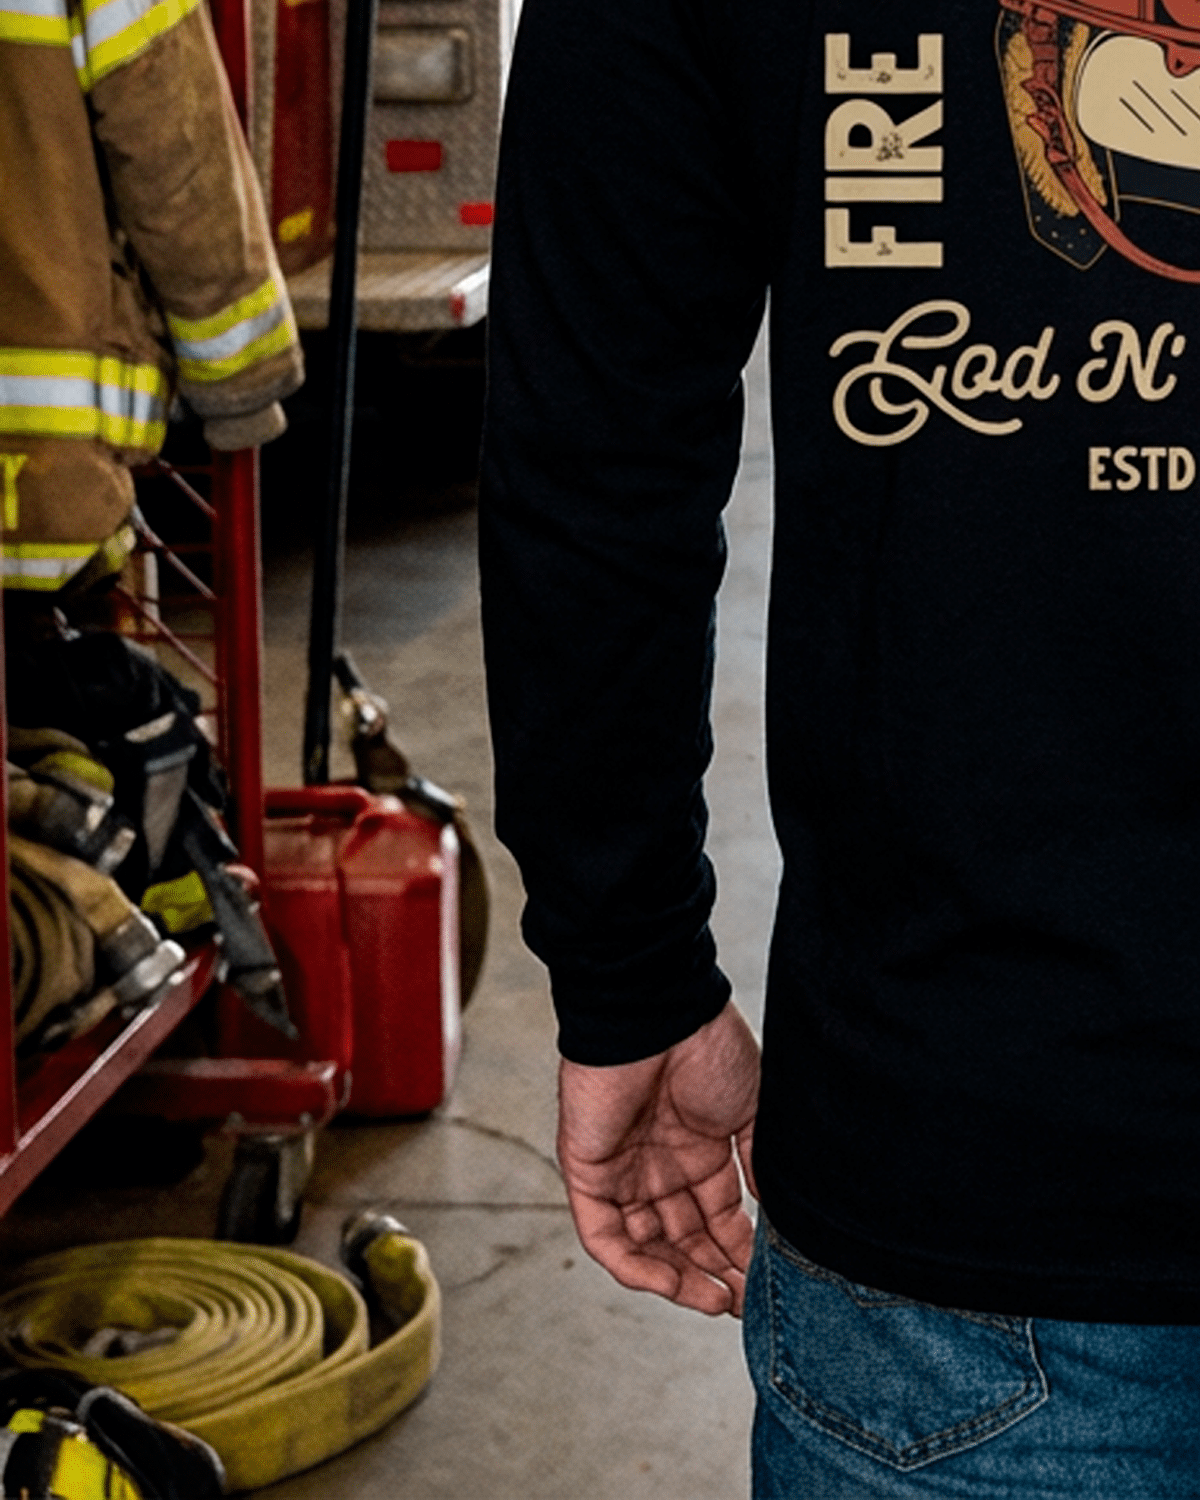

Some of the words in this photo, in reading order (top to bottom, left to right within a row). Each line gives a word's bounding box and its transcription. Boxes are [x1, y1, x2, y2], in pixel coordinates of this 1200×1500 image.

[824, 32, 944, 269] FIRE
[829, 299, 1060, 446] God
[1088, 446, 1196, 491] ESTD
